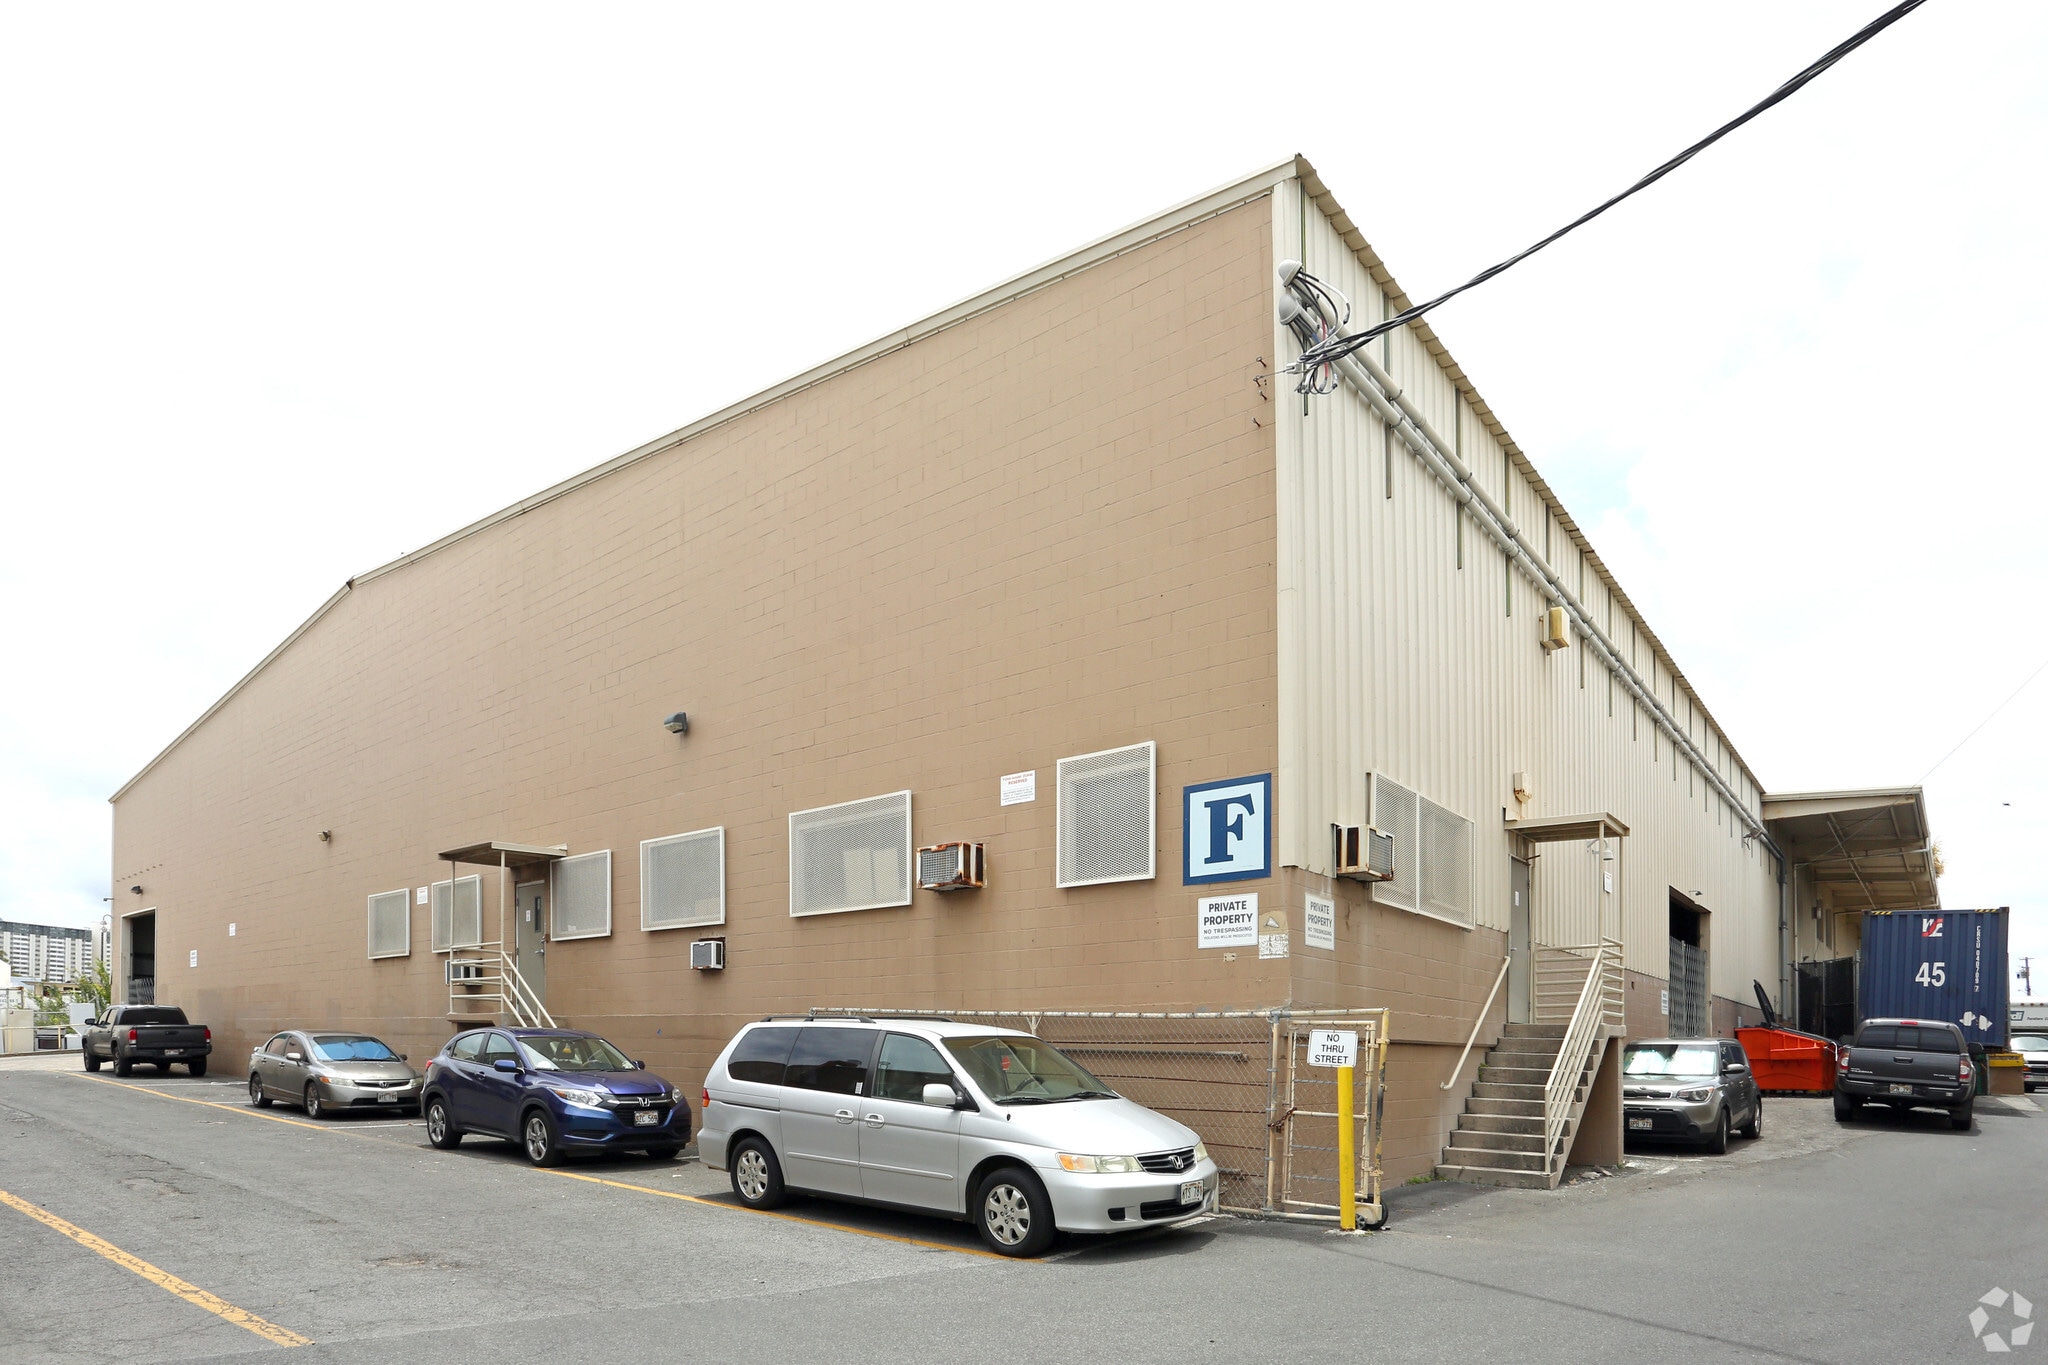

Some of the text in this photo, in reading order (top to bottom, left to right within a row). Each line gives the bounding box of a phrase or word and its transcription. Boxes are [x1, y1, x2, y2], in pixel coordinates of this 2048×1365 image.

[1204, 793, 1255, 865] F
[1208, 900, 1248, 913] PRIVATE
[1310, 901, 1330, 915] PRIVATE
[1203, 913, 1253, 926] PROPERTY
[1308, 913, 1332, 928] PROPERTY
[1213, 926, 1253, 934] TRESPASSING
[1915, 962, 1946, 987] 45
[1326, 1034, 1340, 1042] NO
[1321, 1044, 1345, 1053] THRU
[1314, 1054, 1349, 1064] STREET
